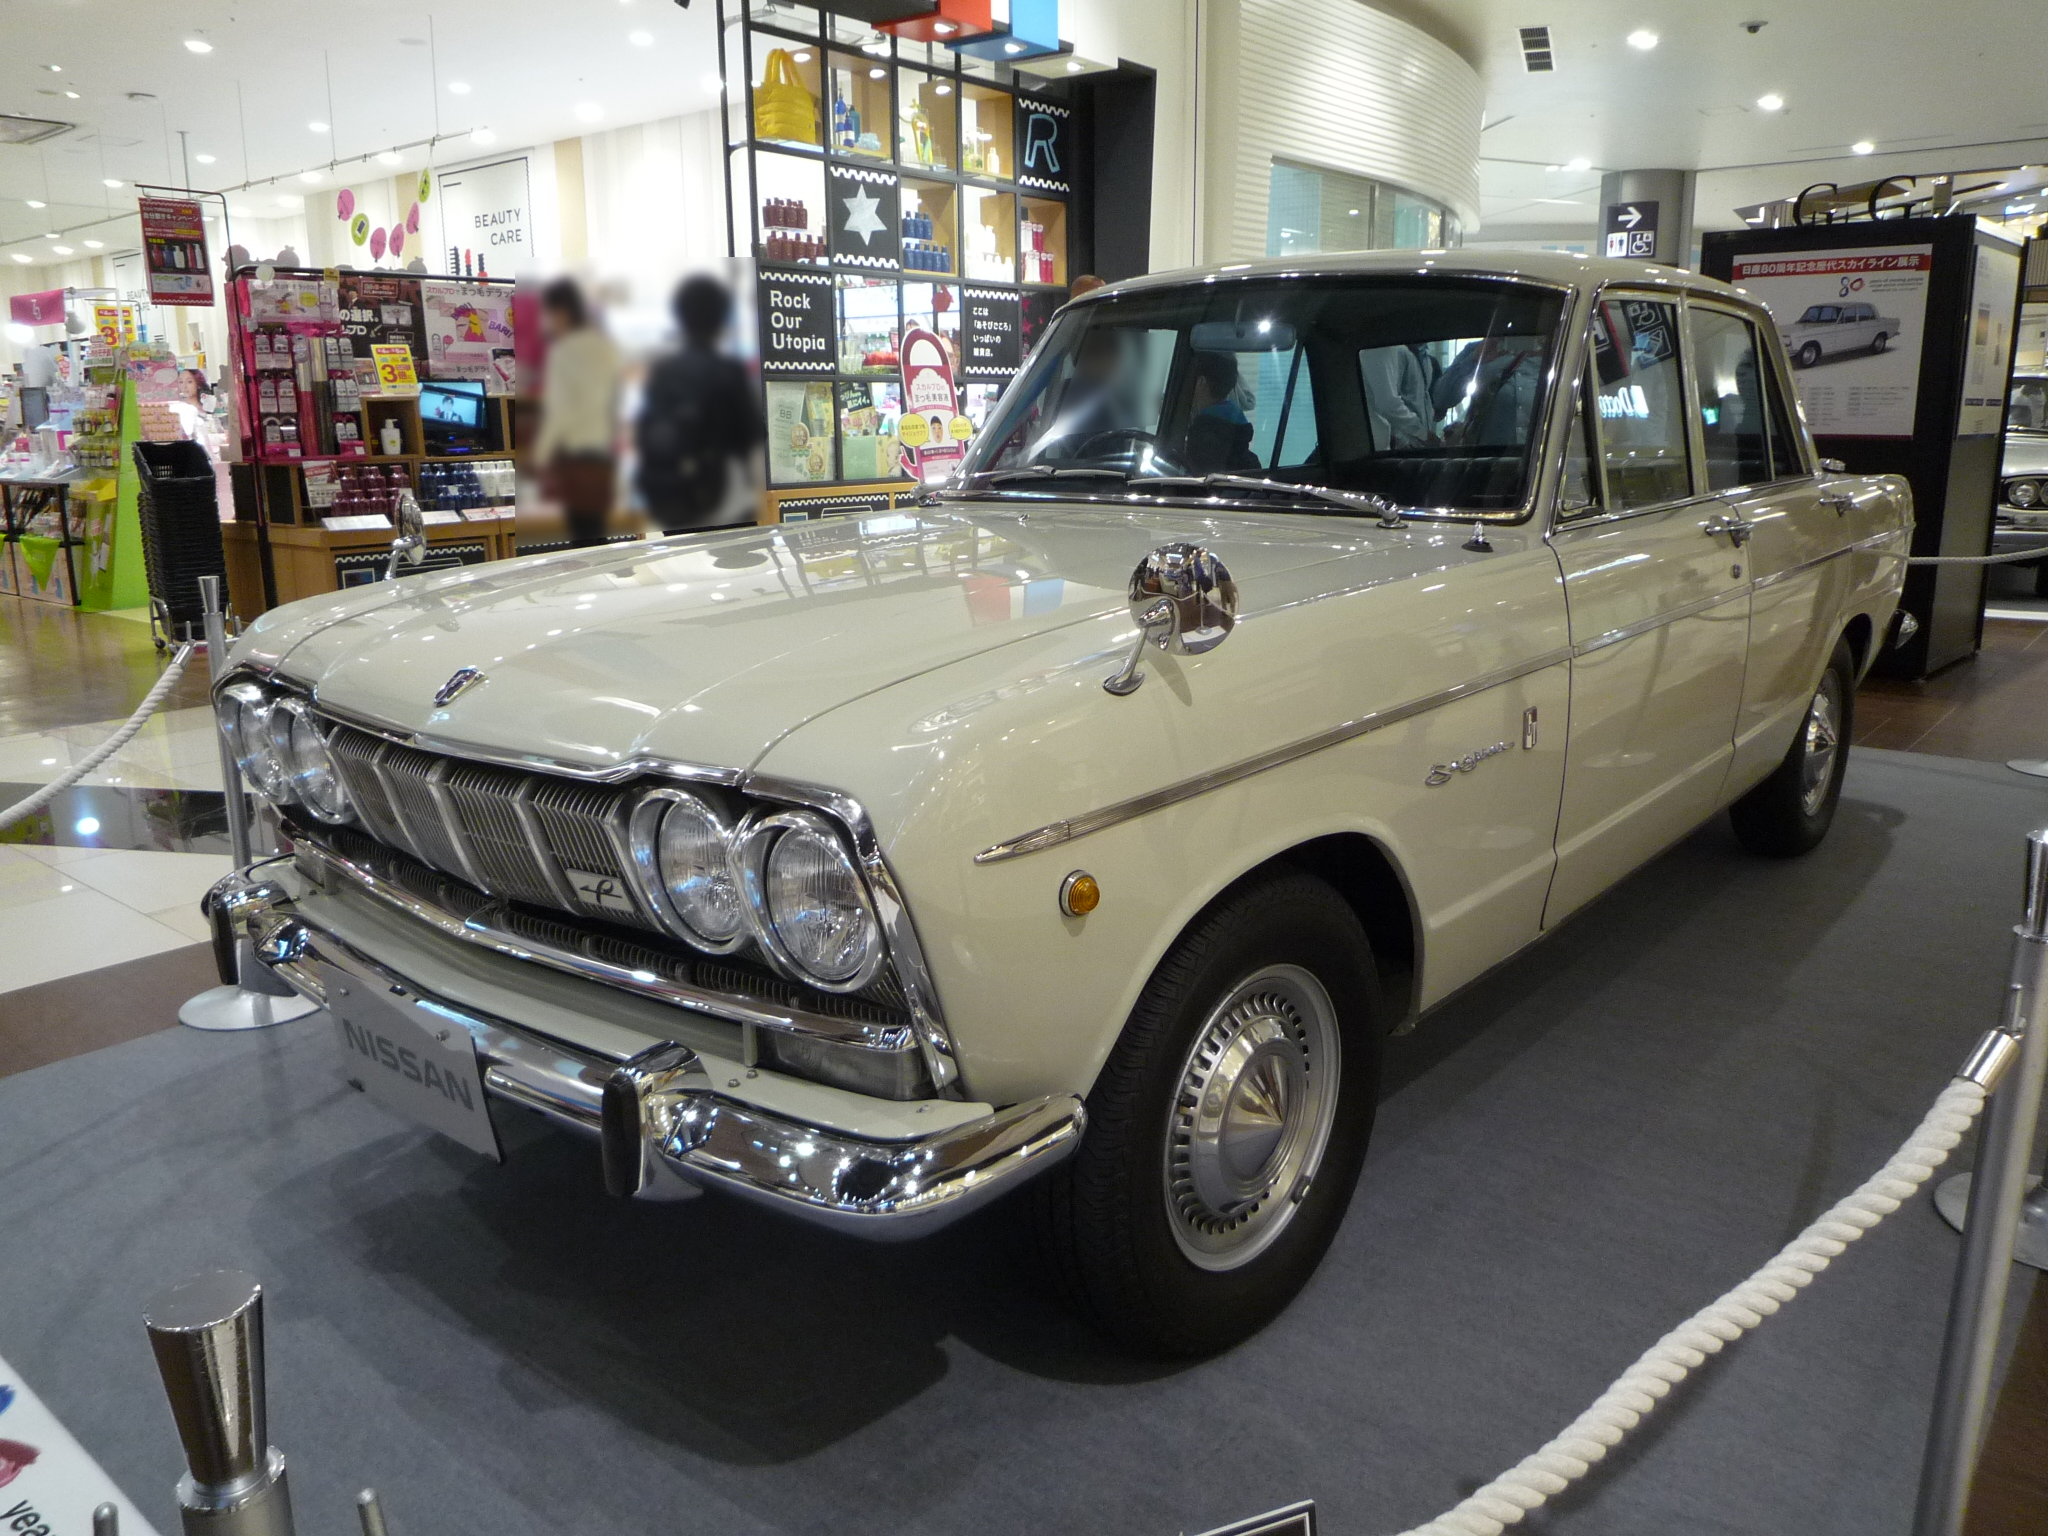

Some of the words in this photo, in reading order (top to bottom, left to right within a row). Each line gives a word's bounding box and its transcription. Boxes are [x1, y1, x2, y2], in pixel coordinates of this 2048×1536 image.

[1025, 113, 1060, 173] R
[474, 208, 521, 228] BEAUTY
[490, 229, 522, 245] CARE
[127, 289, 149, 299] BEAUT
[770, 289, 811, 309] Rock
[771, 312, 802, 328] Our
[972, 307, 989, 316] ここは
[772, 333, 826, 353] Utopia
[973, 334, 1002, 344] いっぱいの
[342, 1017, 475, 1113] NISSAN
[0, 1499, 57, 1536] yea
